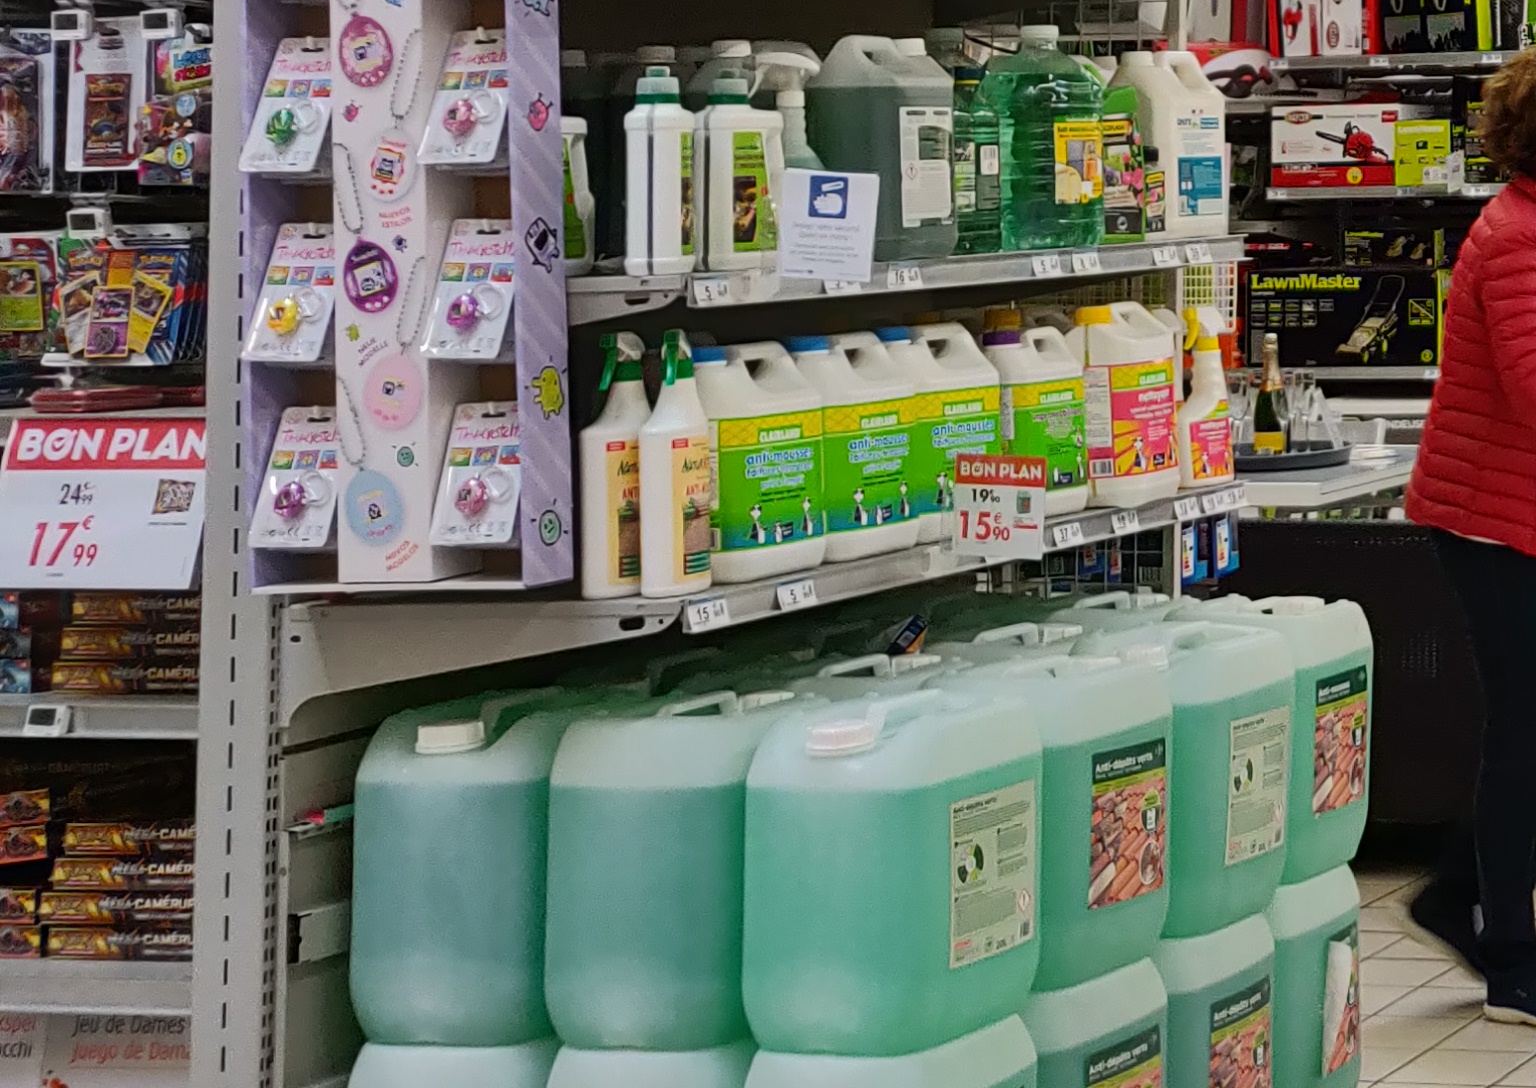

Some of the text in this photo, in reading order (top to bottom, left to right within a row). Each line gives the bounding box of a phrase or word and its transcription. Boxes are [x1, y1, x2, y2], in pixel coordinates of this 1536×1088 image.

[1250, 273, 1363, 291] LawnMaster
[17, 428, 207, 462] BON PLAN
[959, 461, 1043, 480] BON PLAN
[107, 1013, 124, 1034] de
[130, 1013, 185, 1035] Dames
